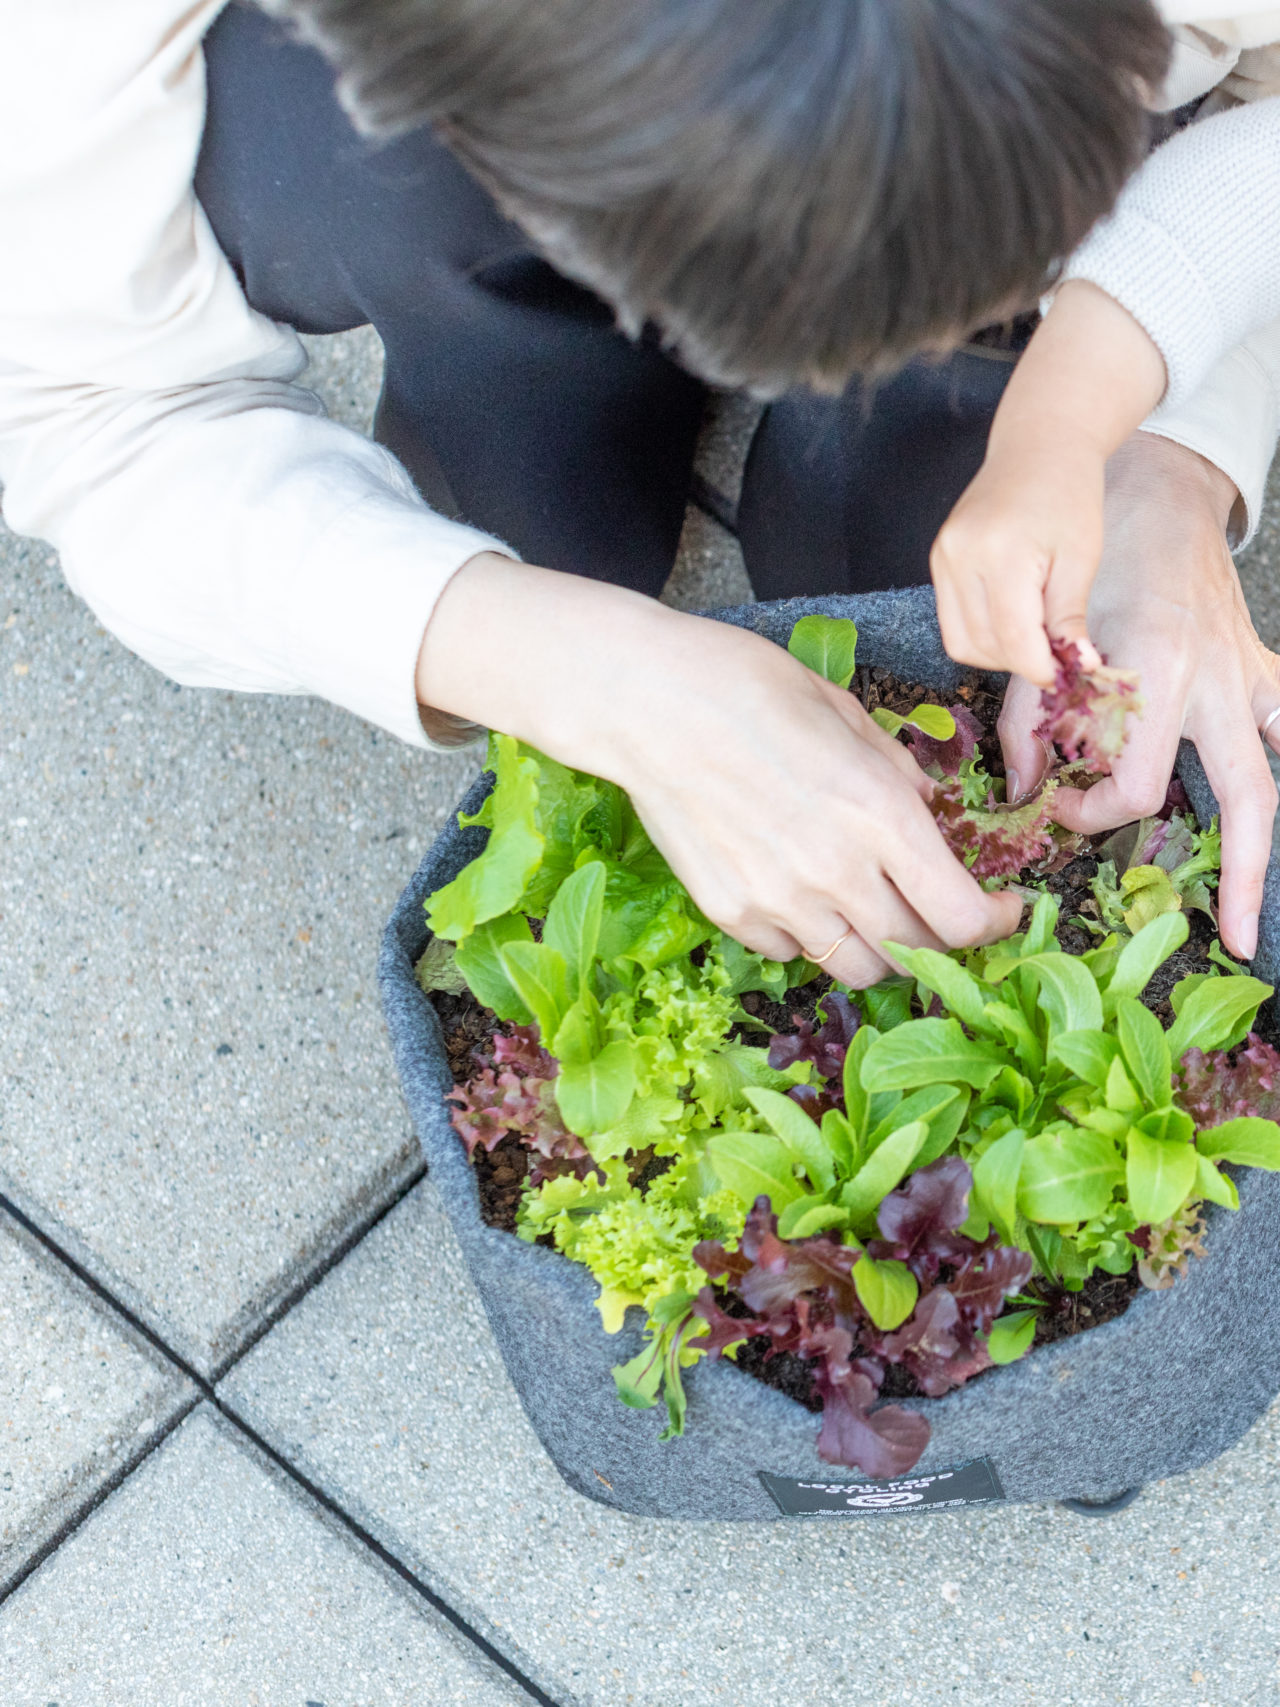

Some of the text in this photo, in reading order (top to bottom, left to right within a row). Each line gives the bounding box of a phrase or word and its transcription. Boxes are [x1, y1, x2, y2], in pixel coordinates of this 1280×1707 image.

[797, 1472, 954, 1490] LOCAL FOOD
[824, 1482, 930, 1494] CYCLING
